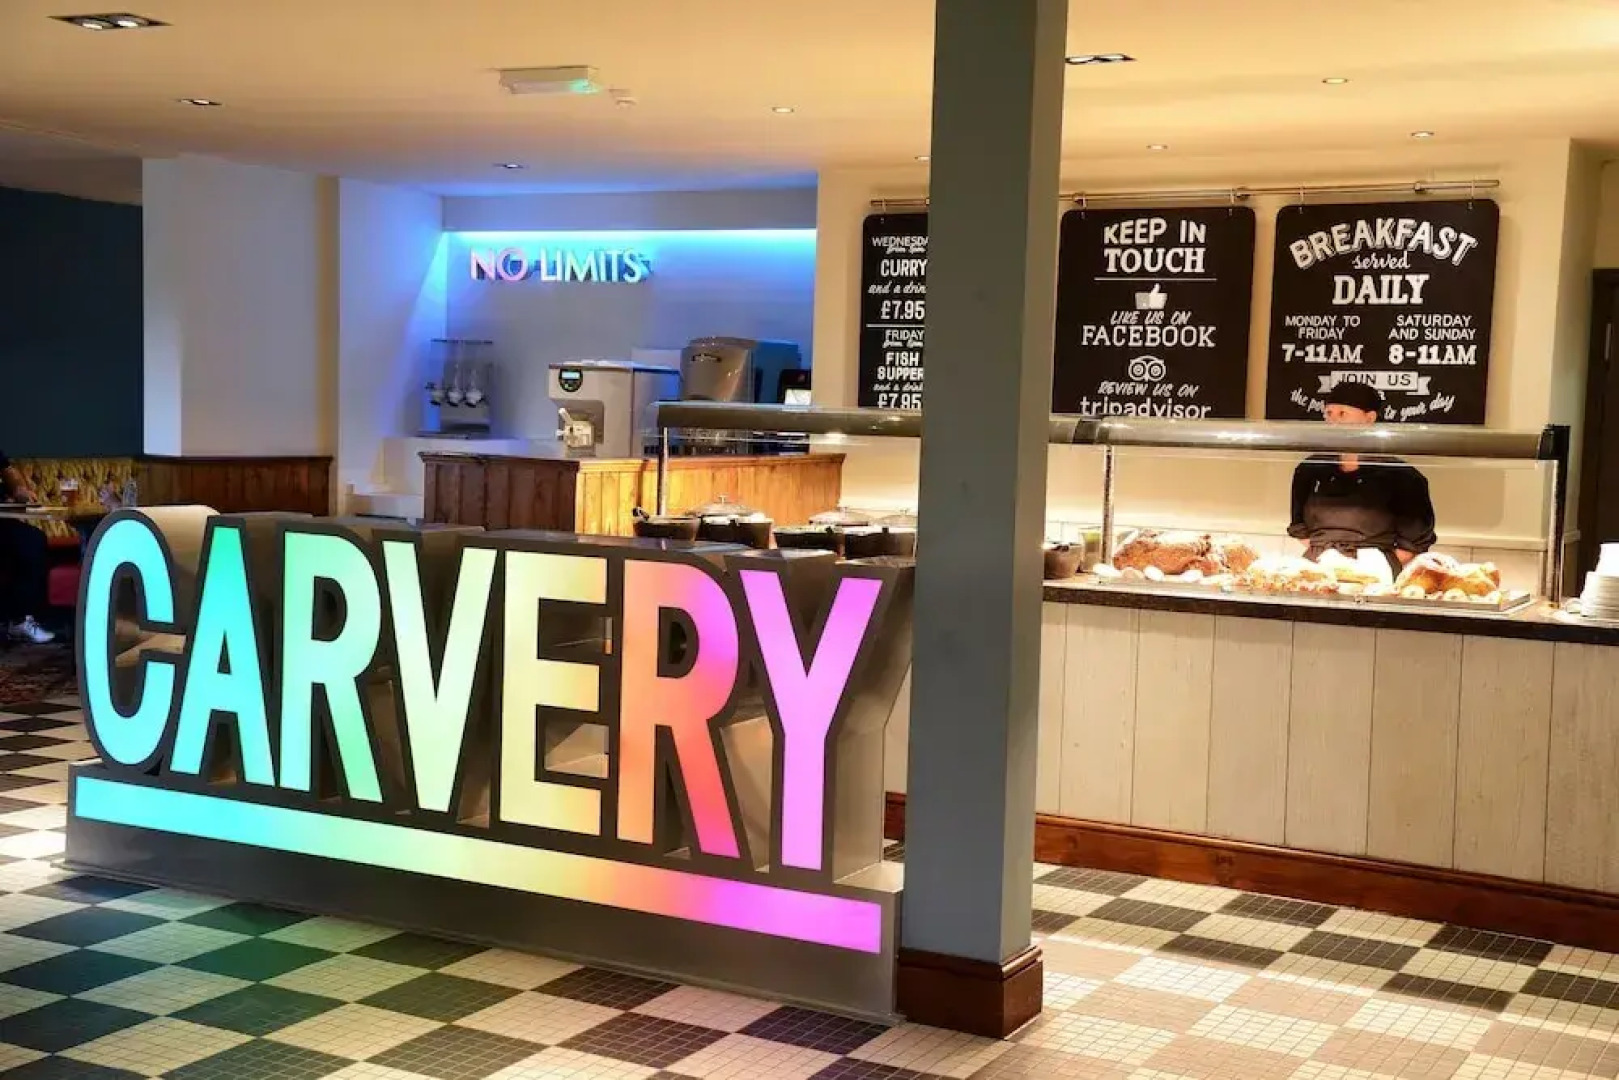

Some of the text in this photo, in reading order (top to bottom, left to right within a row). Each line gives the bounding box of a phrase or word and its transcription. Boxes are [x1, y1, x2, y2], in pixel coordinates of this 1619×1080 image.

[1103, 216, 1207, 245] KEEP IN
[1289, 217, 1479, 270] BREAKFAST
[470, 248, 646, 283] NO LIMITS
[880, 258, 927, 277] CURRY
[1103, 247, 1206, 273] TOUCH
[1352, 250, 1411, 270] served
[868, 282, 926, 294] and a drin
[1332, 273, 1430, 305] DAILY
[880, 300, 925, 320] £7.95
[1110, 310, 1192, 325] LIKE US ON
[1284, 315, 1361, 327] MONDAY TO
[1396, 314, 1472, 327] SATURDAY
[885, 329, 924, 341] FRIDAY
[1081, 325, 1217, 348] FACEBOOK
[1298, 327, 1345, 340] FRIDAY
[1388, 328, 1477, 341] AND SUNDAY
[885, 352, 920, 367] FISH
[1281, 343, 1364, 364] 7-11AM
[1388, 344, 1478, 365] 8-11AM
[1098, 380, 1200, 398] REVIEW US ON
[1388, 374, 1411, 386] US
[877, 393, 922, 409] £7.95
[1290, 387, 1309, 406] the
[1080, 396, 1212, 419] tripadvisor
[1384, 392, 1456, 422] to your day
[83, 517, 883, 872] CARVERY
